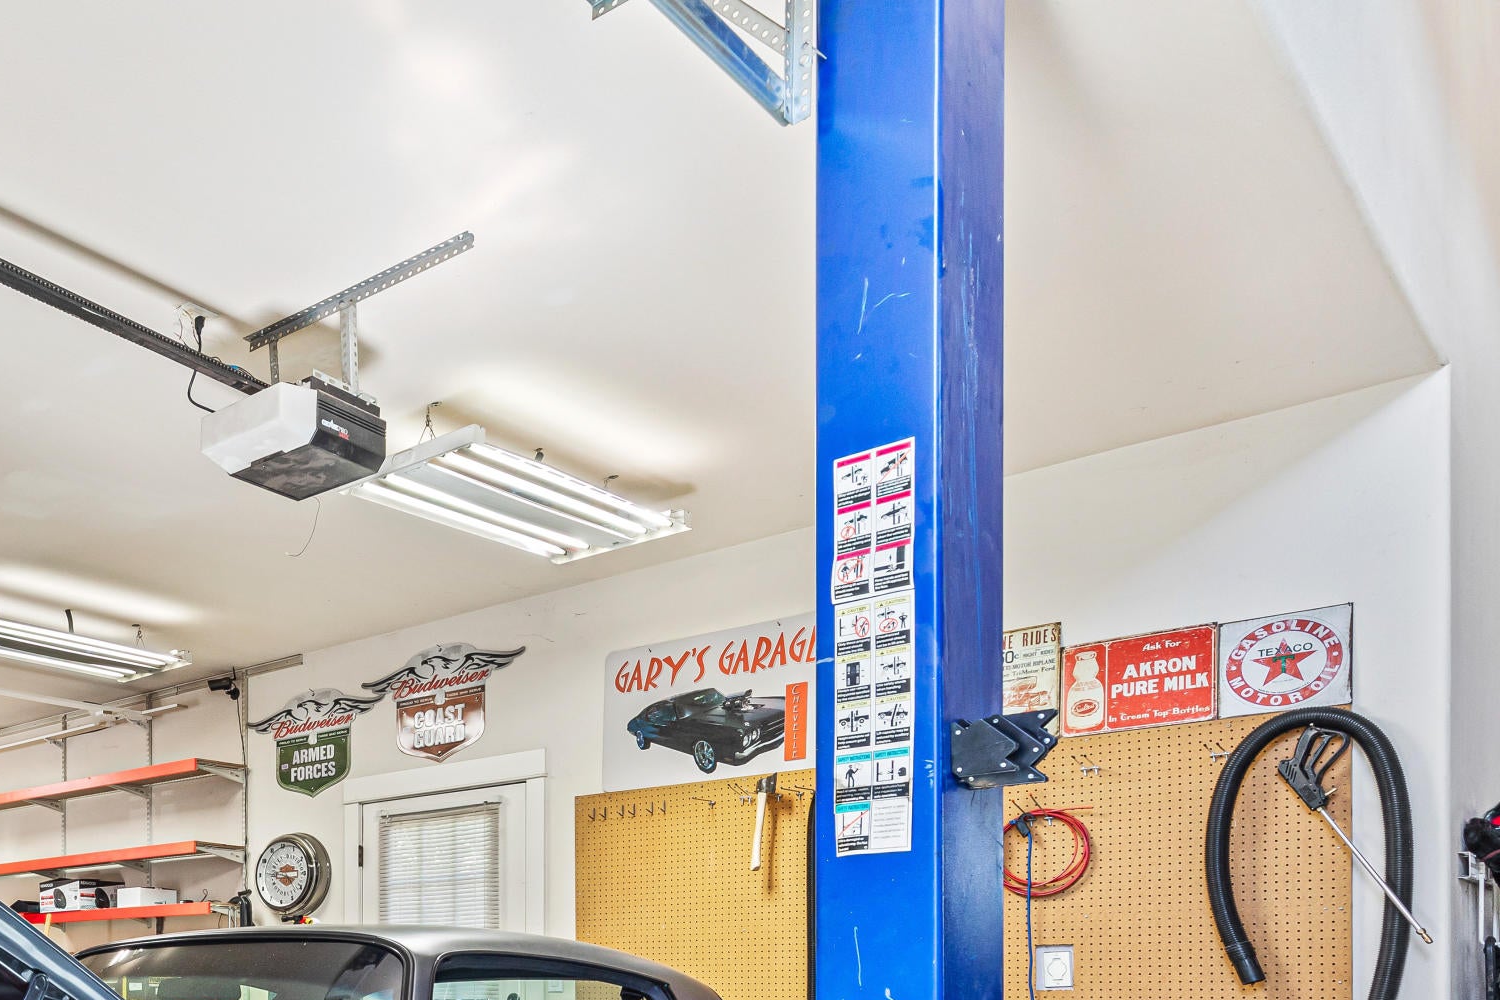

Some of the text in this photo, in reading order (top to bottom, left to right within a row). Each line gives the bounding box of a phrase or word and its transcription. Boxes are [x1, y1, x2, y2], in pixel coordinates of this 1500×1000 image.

[1023, 628, 1056, 647] RIDES
[1142, 639, 1182, 651] Ask For
[1231, 619, 1339, 660] GASOLINE
[1258, 642, 1313, 657] TEXACO
[614, 645, 714, 694] GARY'S
[1041, 665, 1056, 673] Ford
[1122, 655, 1197, 680] AKRON
[1272, 654, 1295, 673] T
[390, 668, 489, 700] Budweiser
[1111, 679, 1159, 699] PURE
[1164, 672, 1209, 692] MILK
[1310, 664, 1340, 691] OIL
[1229, 676, 1304, 706] MOTOR
[414, 703, 466, 729] COAST
[1108, 715, 1117, 723] In
[1120, 712, 1150, 721] Cream
[1172, 704, 1211, 715] Bottles
[271, 713, 354, 740] Budweiser
[414, 724, 466, 749] GUARD
[292, 744, 335, 765] ARMED
[290, 761, 336, 783] FORCES
